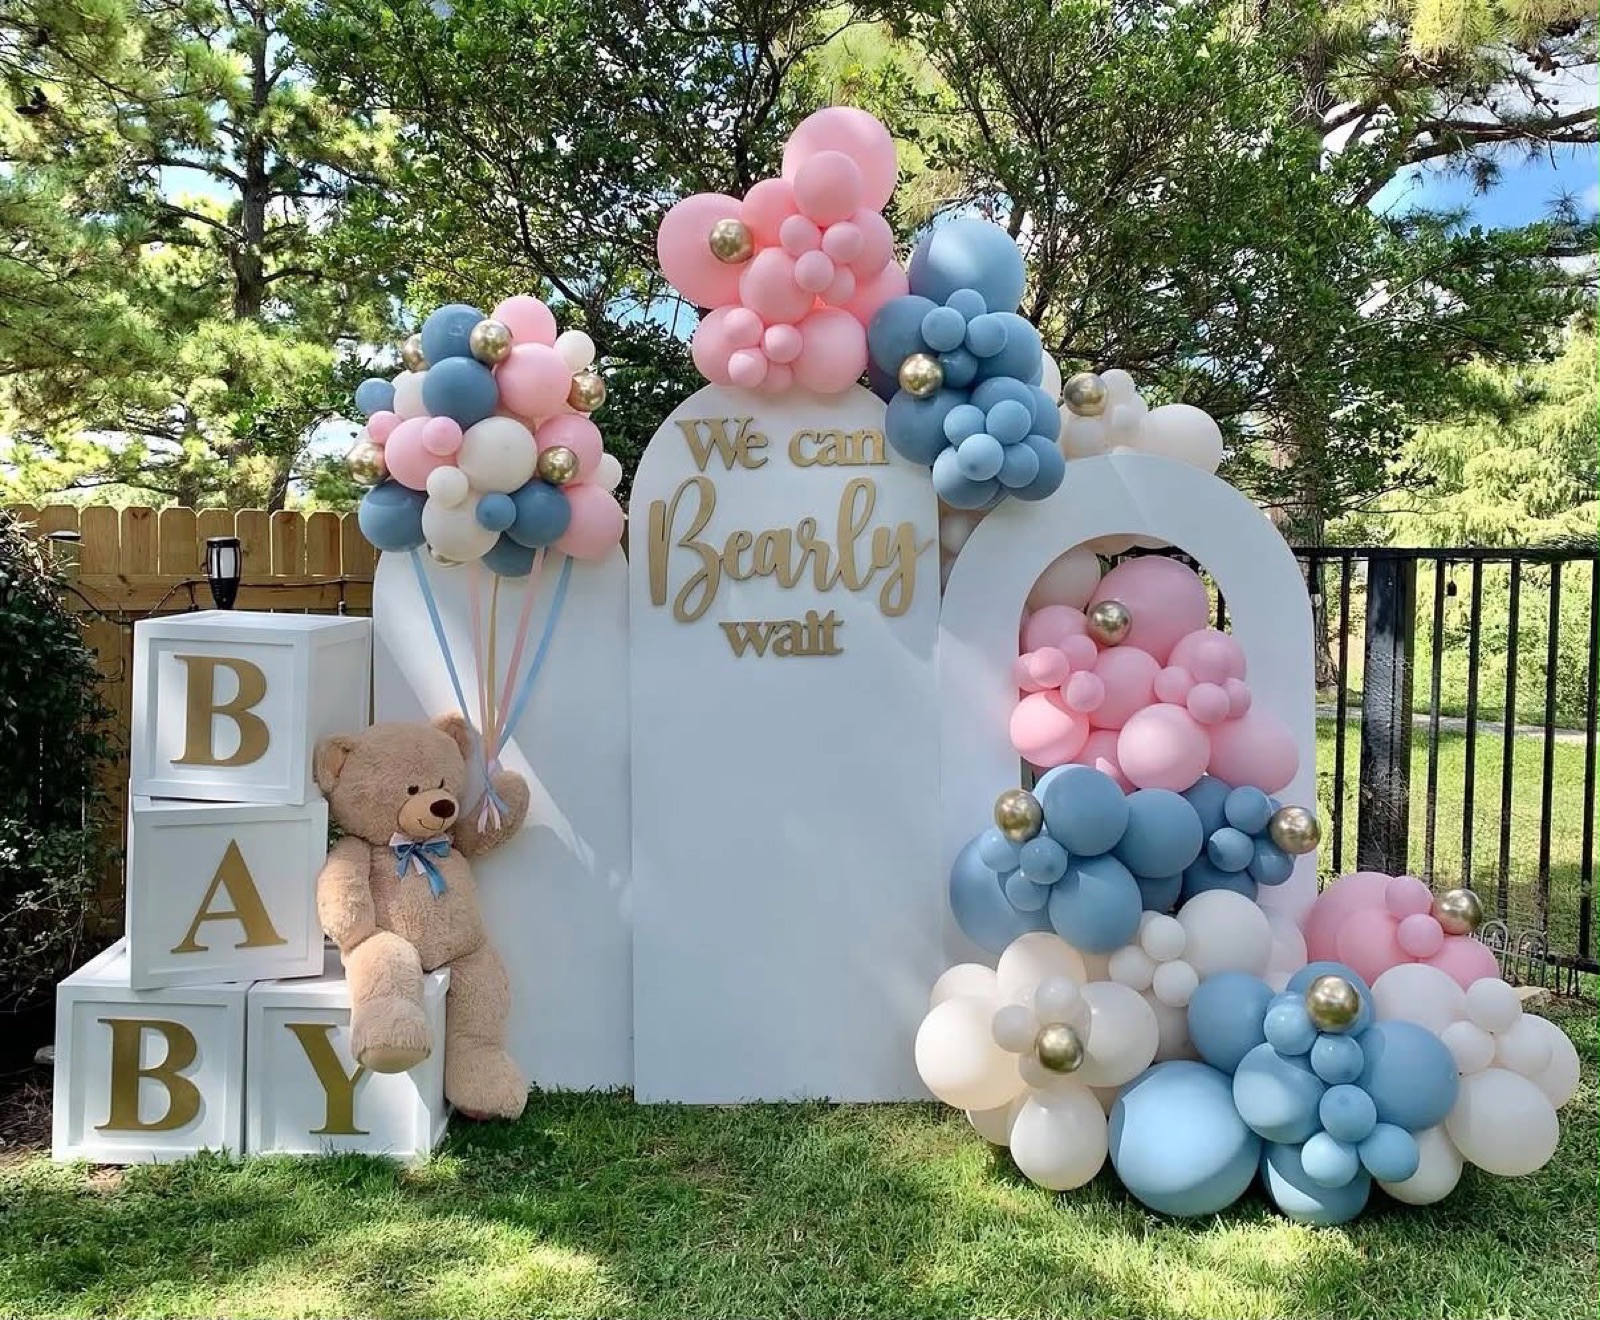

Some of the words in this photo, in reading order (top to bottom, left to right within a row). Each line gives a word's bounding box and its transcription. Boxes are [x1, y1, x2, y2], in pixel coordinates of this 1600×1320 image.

[674, 416, 769, 471] We
[788, 428, 889, 467] can
[648, 475, 935, 623] Bearly
[718, 609, 845, 658] wait
[169, 654, 270, 767] B
[170, 838, 288, 954] A
